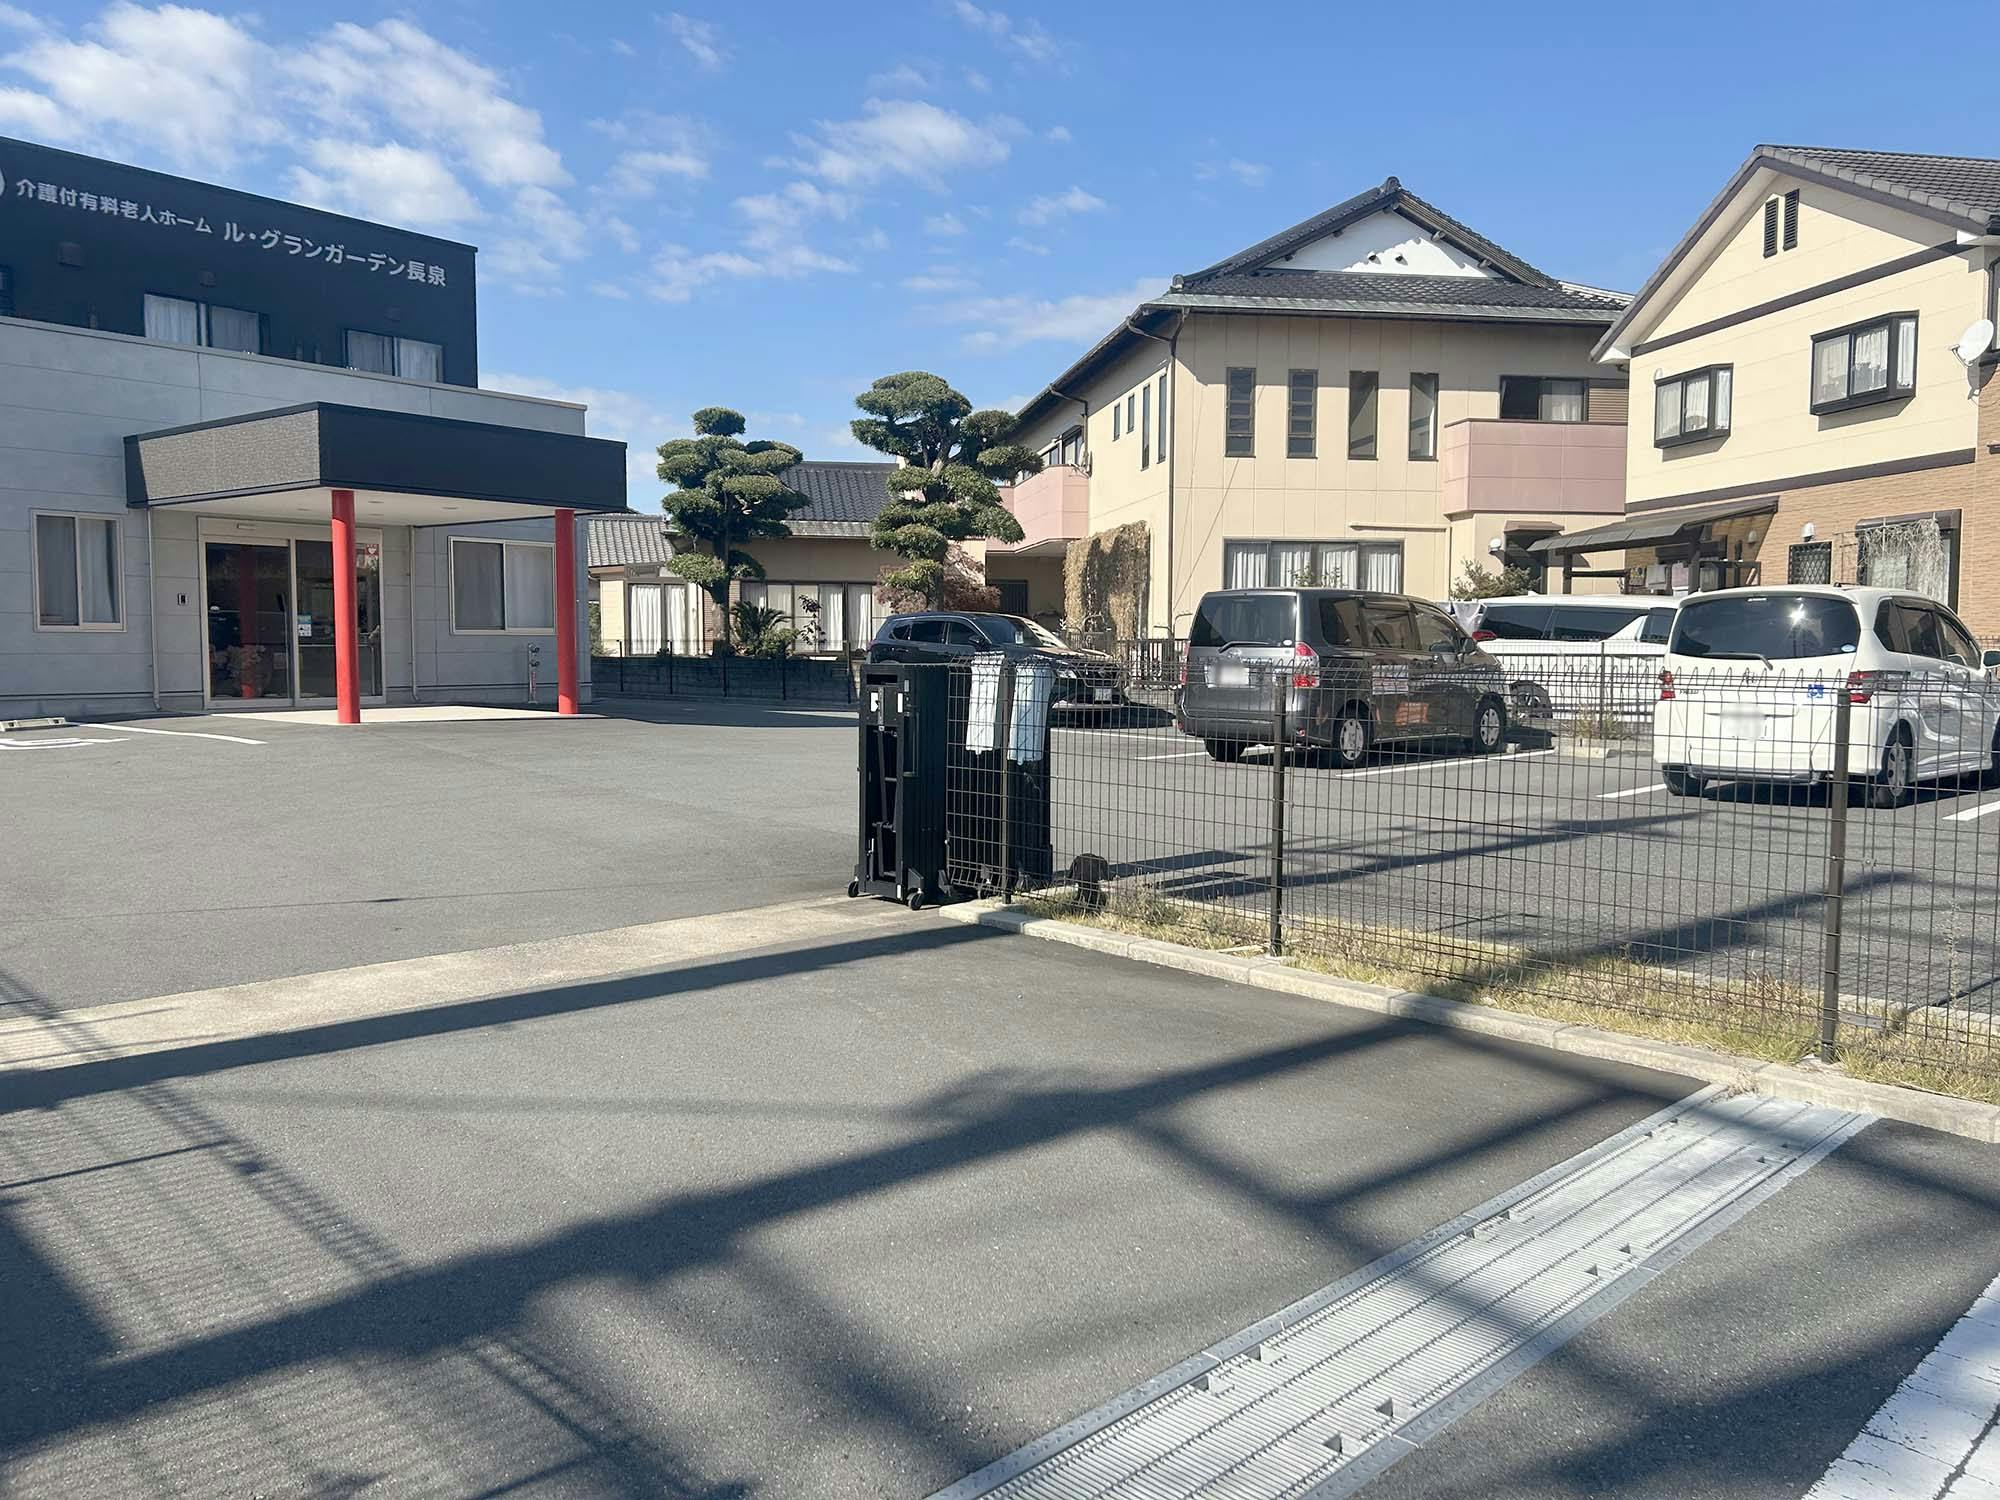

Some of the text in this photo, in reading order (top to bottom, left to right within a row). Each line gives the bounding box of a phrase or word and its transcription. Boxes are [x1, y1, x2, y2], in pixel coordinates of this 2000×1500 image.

[16, 178, 447, 287] 介護付有料老人ホーム ル・グランガーデン長泉
